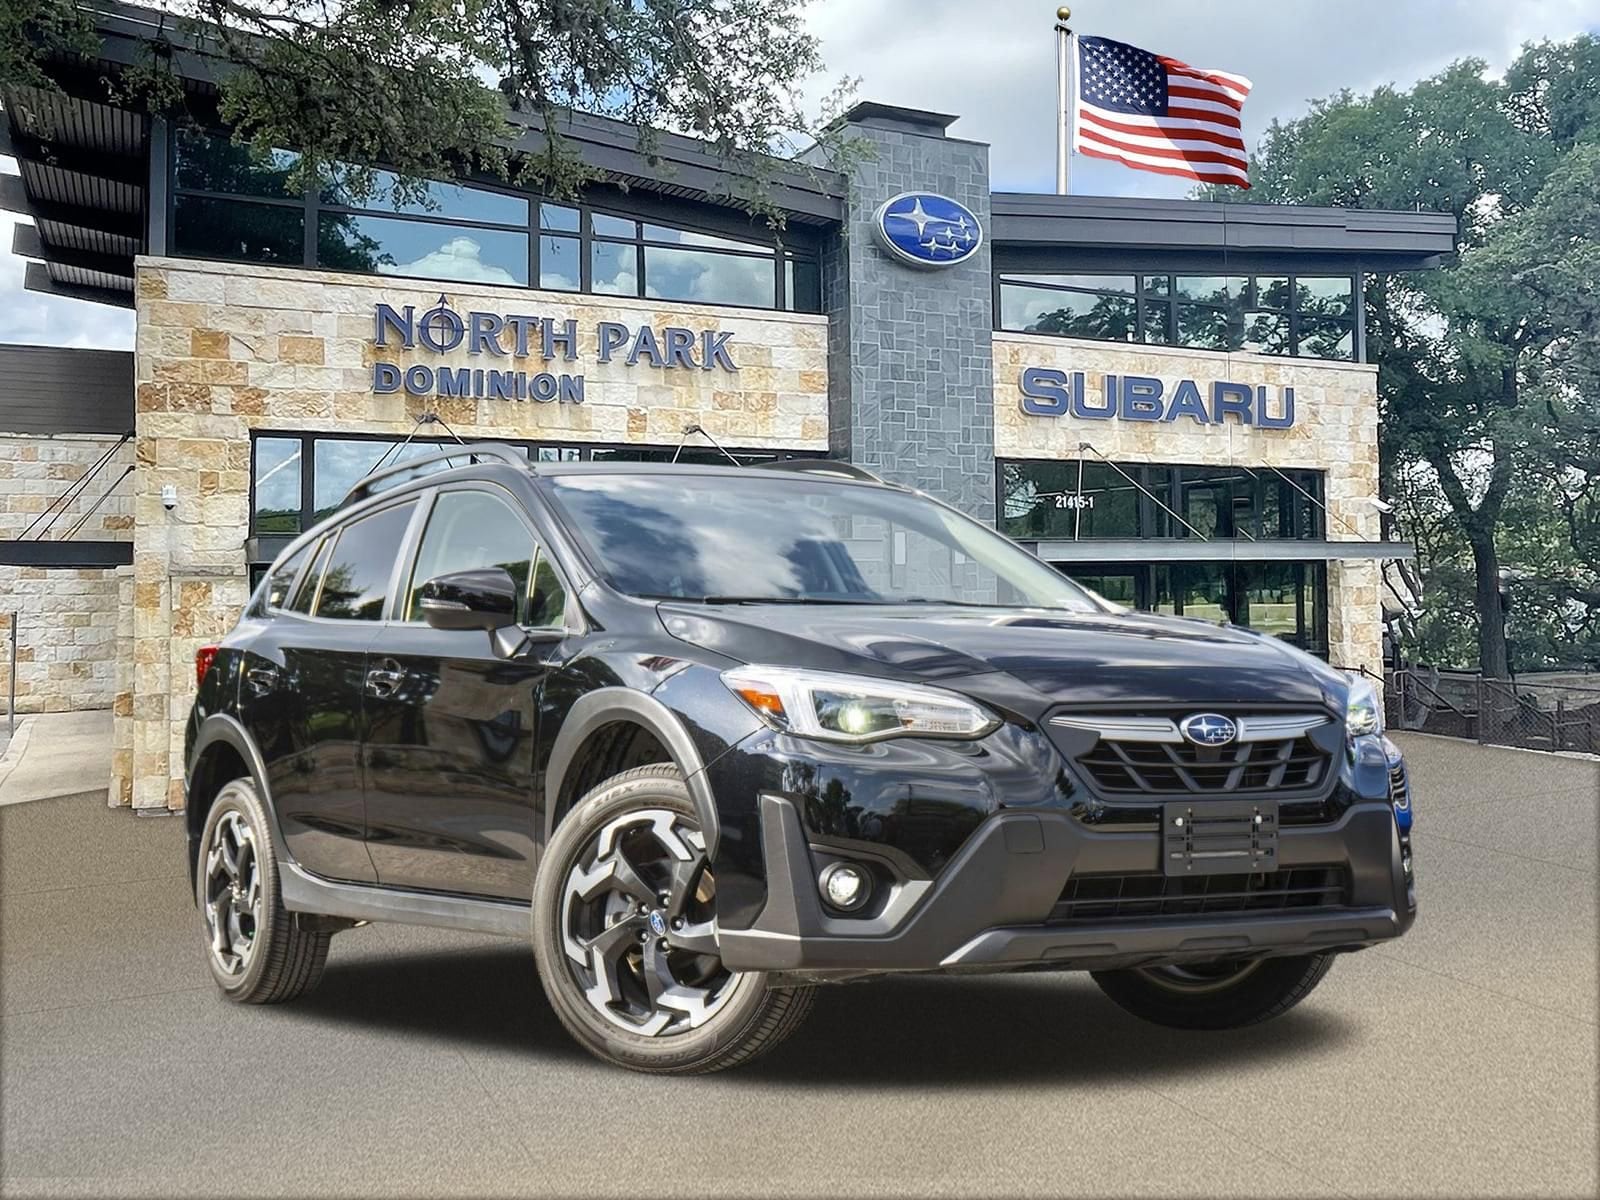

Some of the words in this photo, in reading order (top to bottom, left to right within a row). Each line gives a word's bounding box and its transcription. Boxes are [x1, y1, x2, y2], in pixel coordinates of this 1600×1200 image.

[374, 301, 579, 361] NORTH
[596, 320, 742, 373] PARK
[372, 362, 585, 404] DOMINION
[1018, 366, 1295, 429] SUBARU
